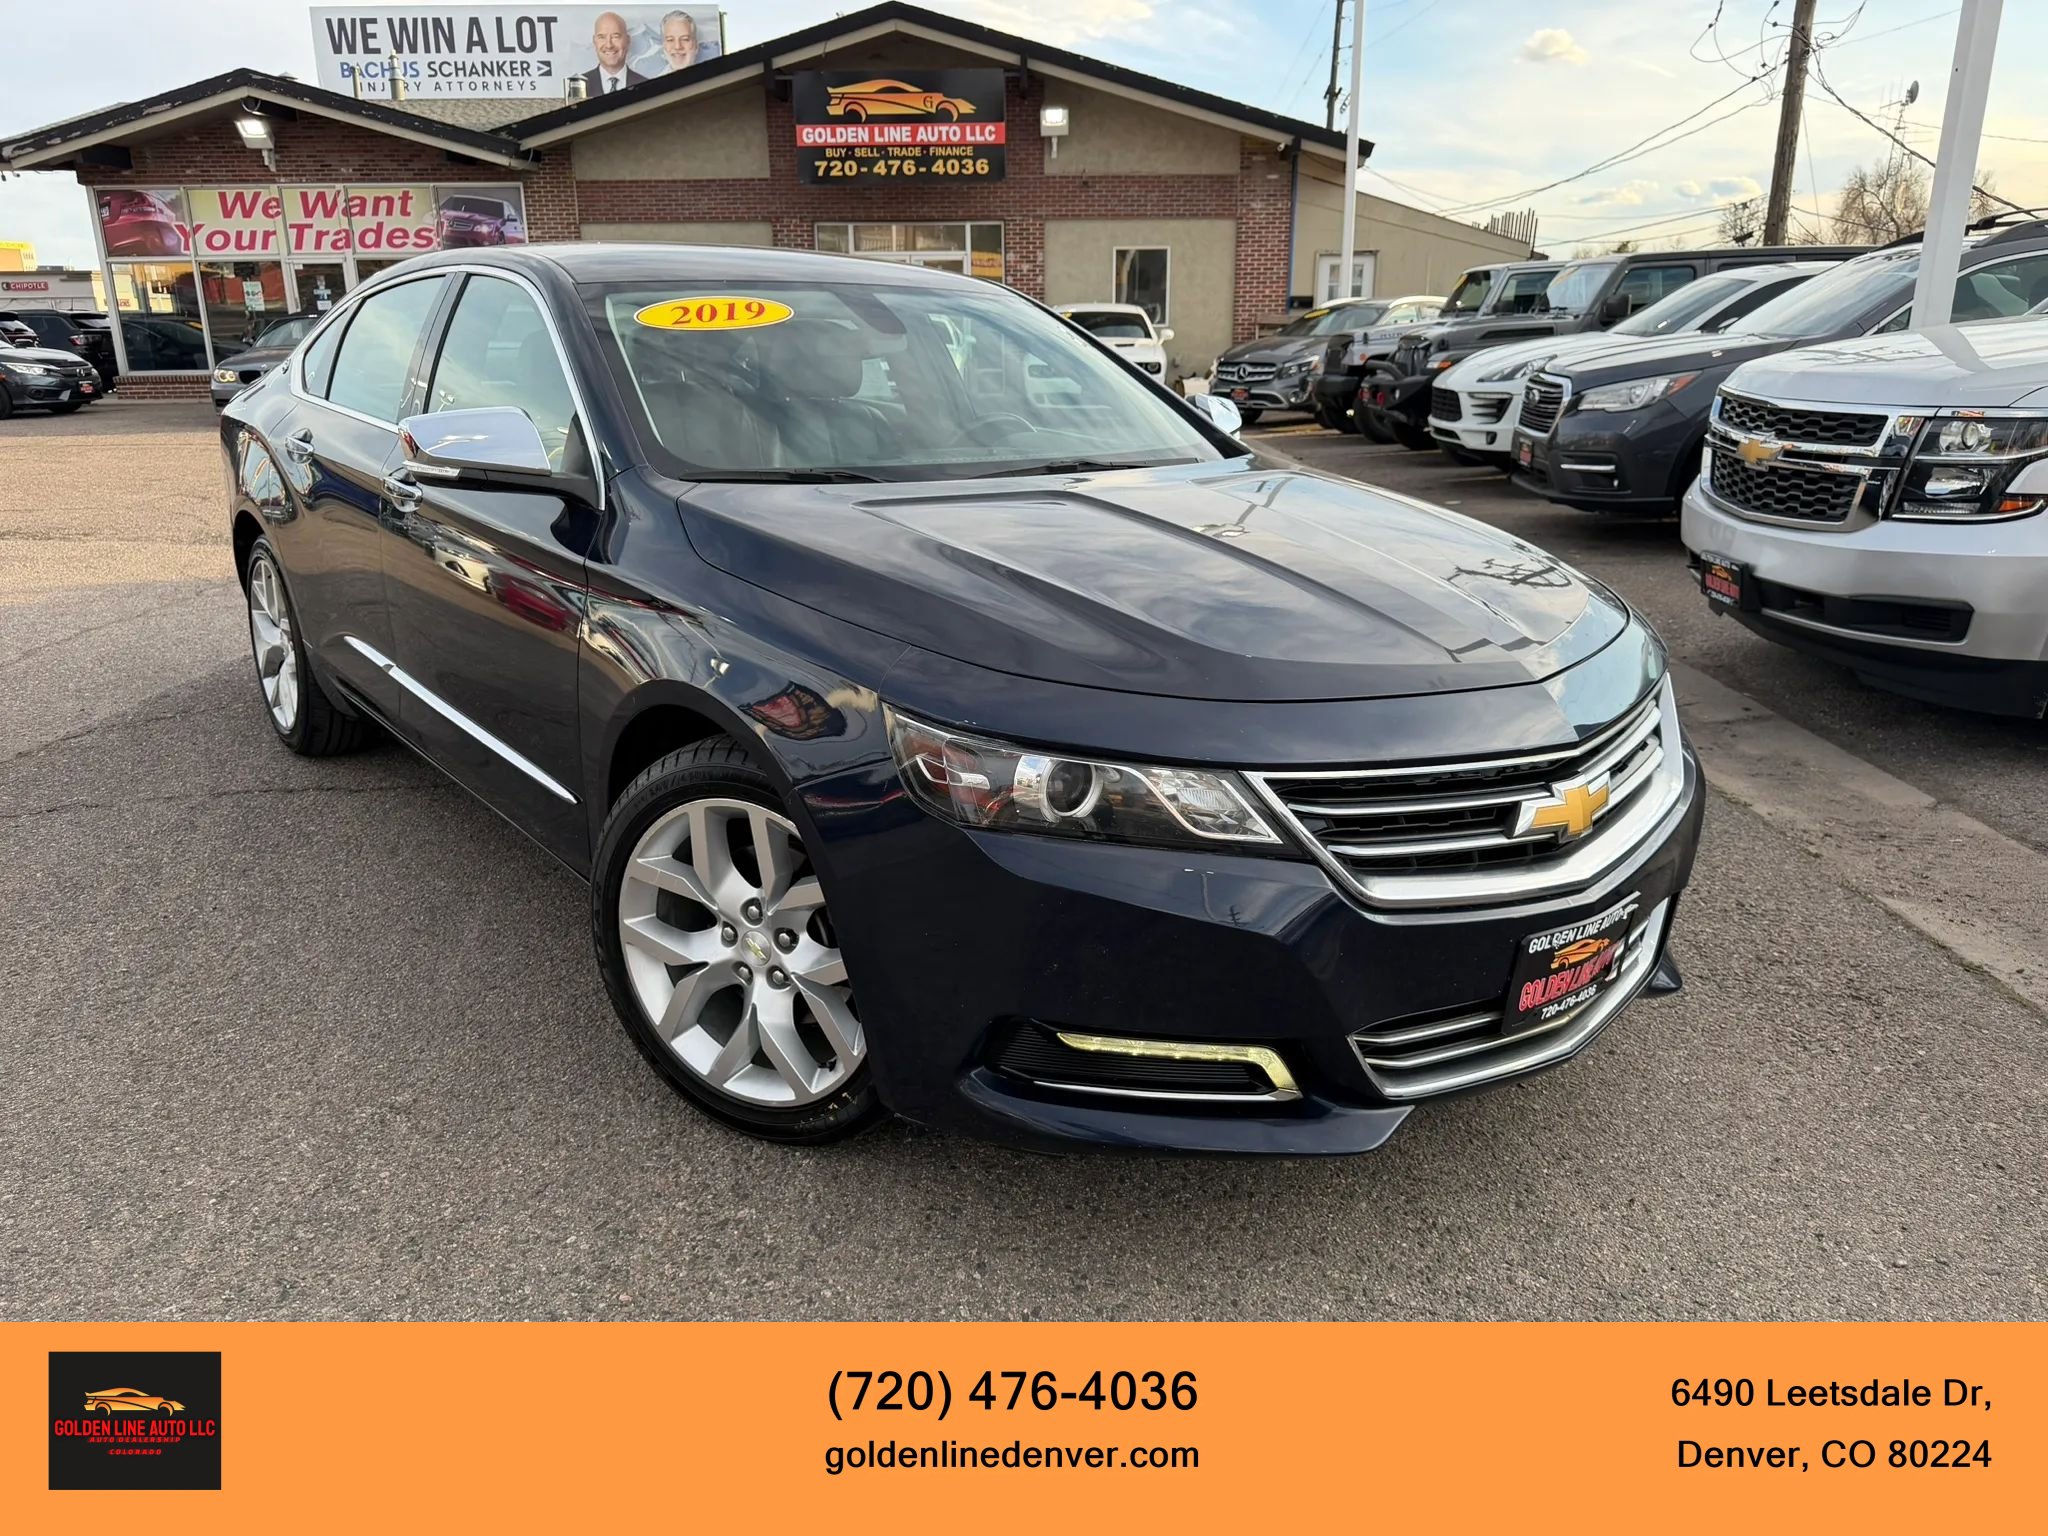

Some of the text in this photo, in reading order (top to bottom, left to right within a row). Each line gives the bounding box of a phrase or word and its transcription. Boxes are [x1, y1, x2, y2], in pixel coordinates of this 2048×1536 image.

[325, 15, 558, 55] WE WIN A LOT
[427, 60, 532, 78] SCHANKER
[360, 80, 537, 92] INJRY ATTORNEYS
[802, 126, 996, 143] GOLDEN LINE AUTO LLC
[825, 146, 974, 157] BUY SELL TRADE FINANCE
[814, 159, 990, 177] 720-476-4036
[217, 190, 414, 219] We Want
[174, 223, 278, 251] Your
[11, 282, 46, 290] CHIPOTLE
[671, 301, 765, 325] 2019
[1528, 929, 1577, 954] GOLDEN
[1576, 919, 1603, 941] LINE
[1519, 967, 1576, 1012] GOLDEN
